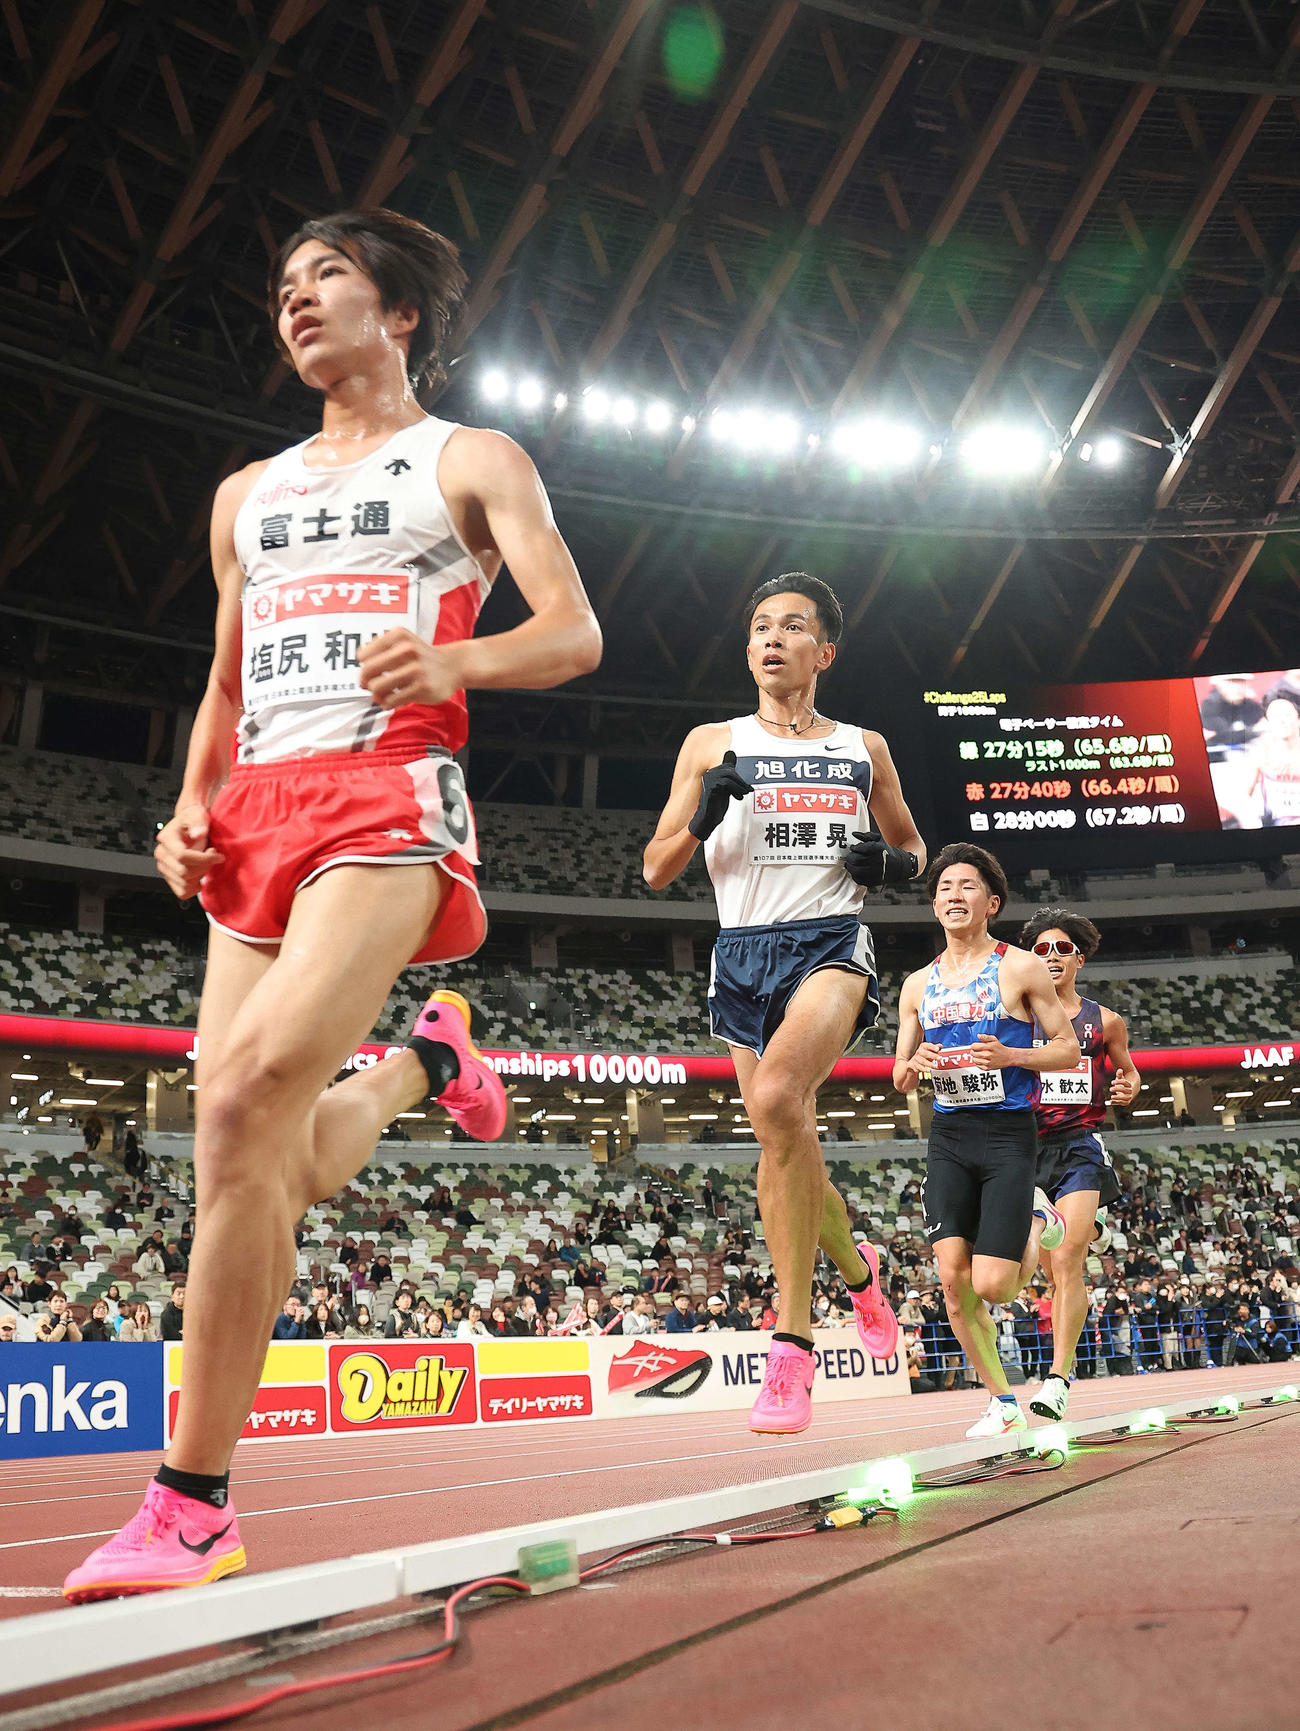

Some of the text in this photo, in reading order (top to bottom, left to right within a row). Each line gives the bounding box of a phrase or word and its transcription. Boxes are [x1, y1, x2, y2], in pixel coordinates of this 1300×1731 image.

[260, 500, 389, 551] 富士通
[282, 582, 401, 612] ヤマザキ
[249, 630, 390, 683] 塩尻 和
[754, 760, 854, 781] 旭化成
[781, 792, 854, 810] ヤマザキ
[966, 782, 985, 801] 赤
[990, 780, 1072, 800] 27分40秒
[970, 812, 989, 831] 白
[994, 808, 1077, 831] 28分00秒
[765, 822, 848, 849] 相澤 晃
[932, 1001, 986, 1024] 中国電力
[482, 1052, 687, 1084] onships 10000m
[1240, 1046, 1294, 1069] JAAF
[961, 1072, 999, 1093] 駿弥
[1041, 1079, 1089, 1094] 水 歓太
[0, 1364, 129, 1434] nka
[339, 1354, 467, 1421] Daily
[382, 1401, 437, 1417] YAMAZAKI
[488, 1396, 584, 1414] デイリーヤマザキ
[246, 1408, 316, 1430] ヤマザキ
